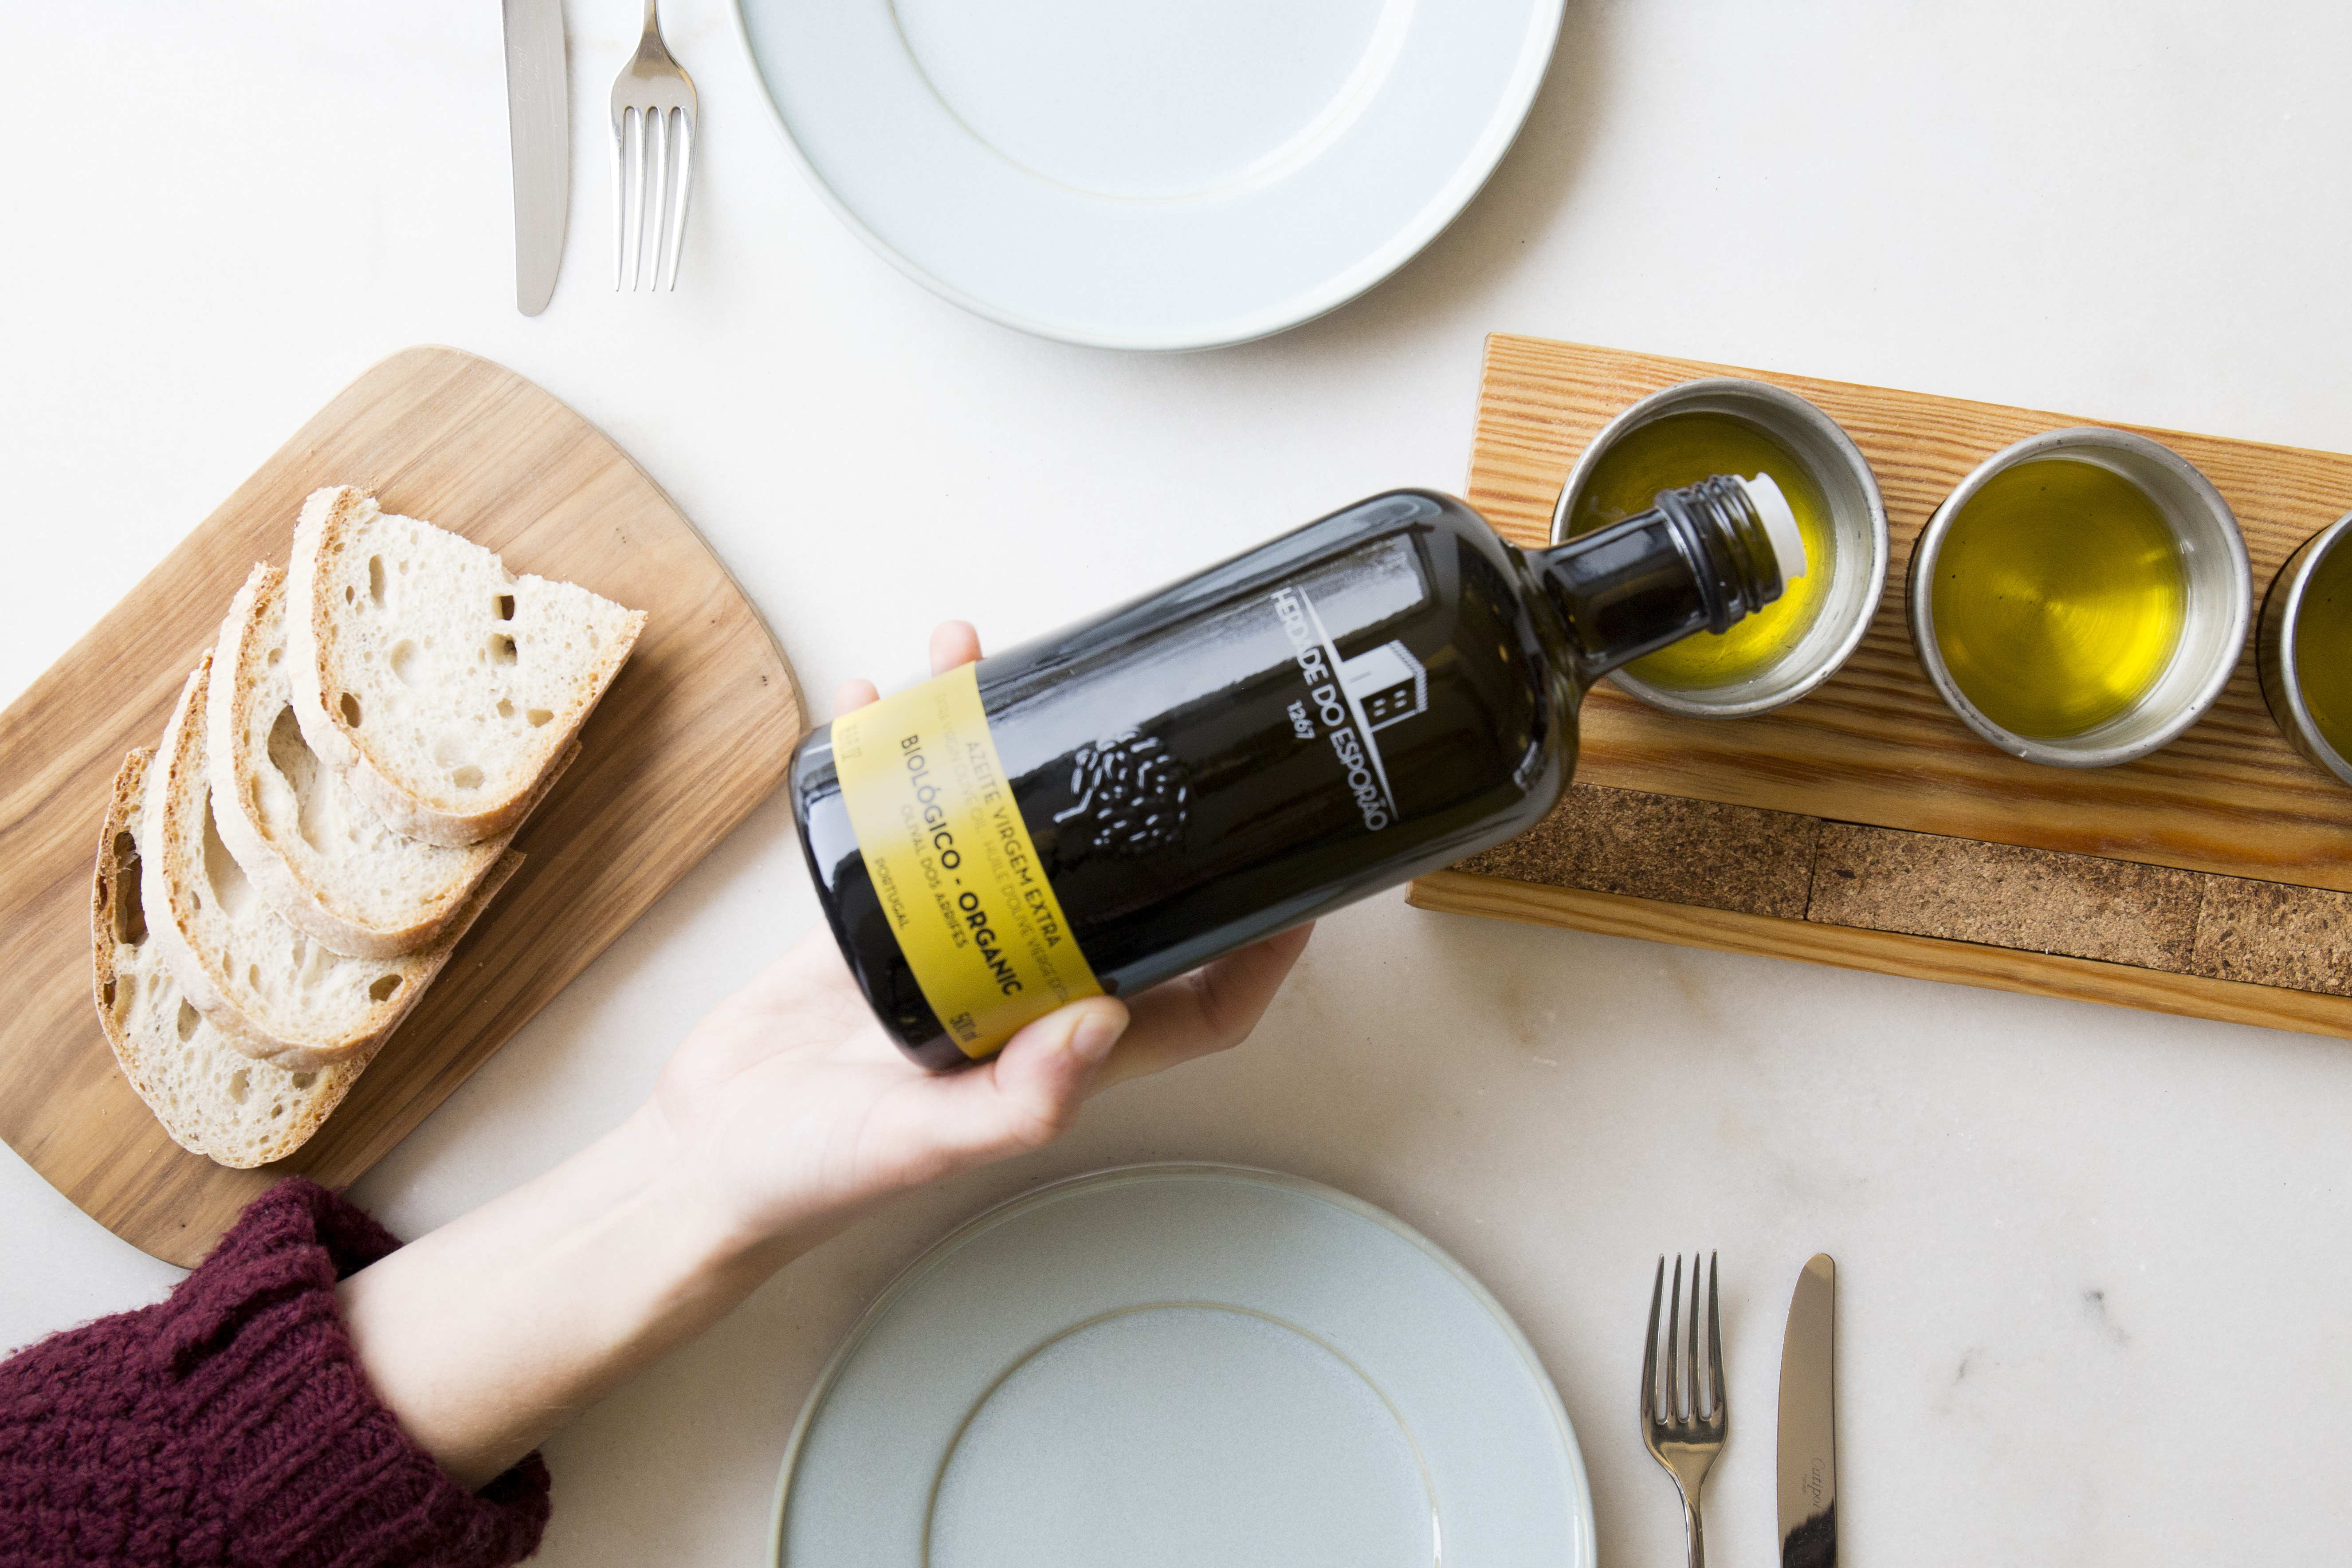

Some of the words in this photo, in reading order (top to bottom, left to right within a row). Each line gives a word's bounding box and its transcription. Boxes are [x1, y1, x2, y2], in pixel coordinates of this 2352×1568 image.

[1269, 587, 1330, 686] HERDADE
[1310, 682, 1345, 726] DO
[1328, 726, 1387, 830] ESPORÃO
[1286, 699, 1316, 737] 1267
[874, 857, 908, 929] PORTUGAL
[900, 735, 960, 868] BIOLÓGICO
[960, 892, 1021, 996] ORGANIC
[901, 806, 926, 855] OLIVAL
[919, 857, 942, 889] DOS
[934, 895, 968, 949] ARRIFES
[966, 743, 1000, 805] AZEITE
[993, 806, 1034, 886] VIRGEM
[1024, 888, 1061, 948] EXTRA
